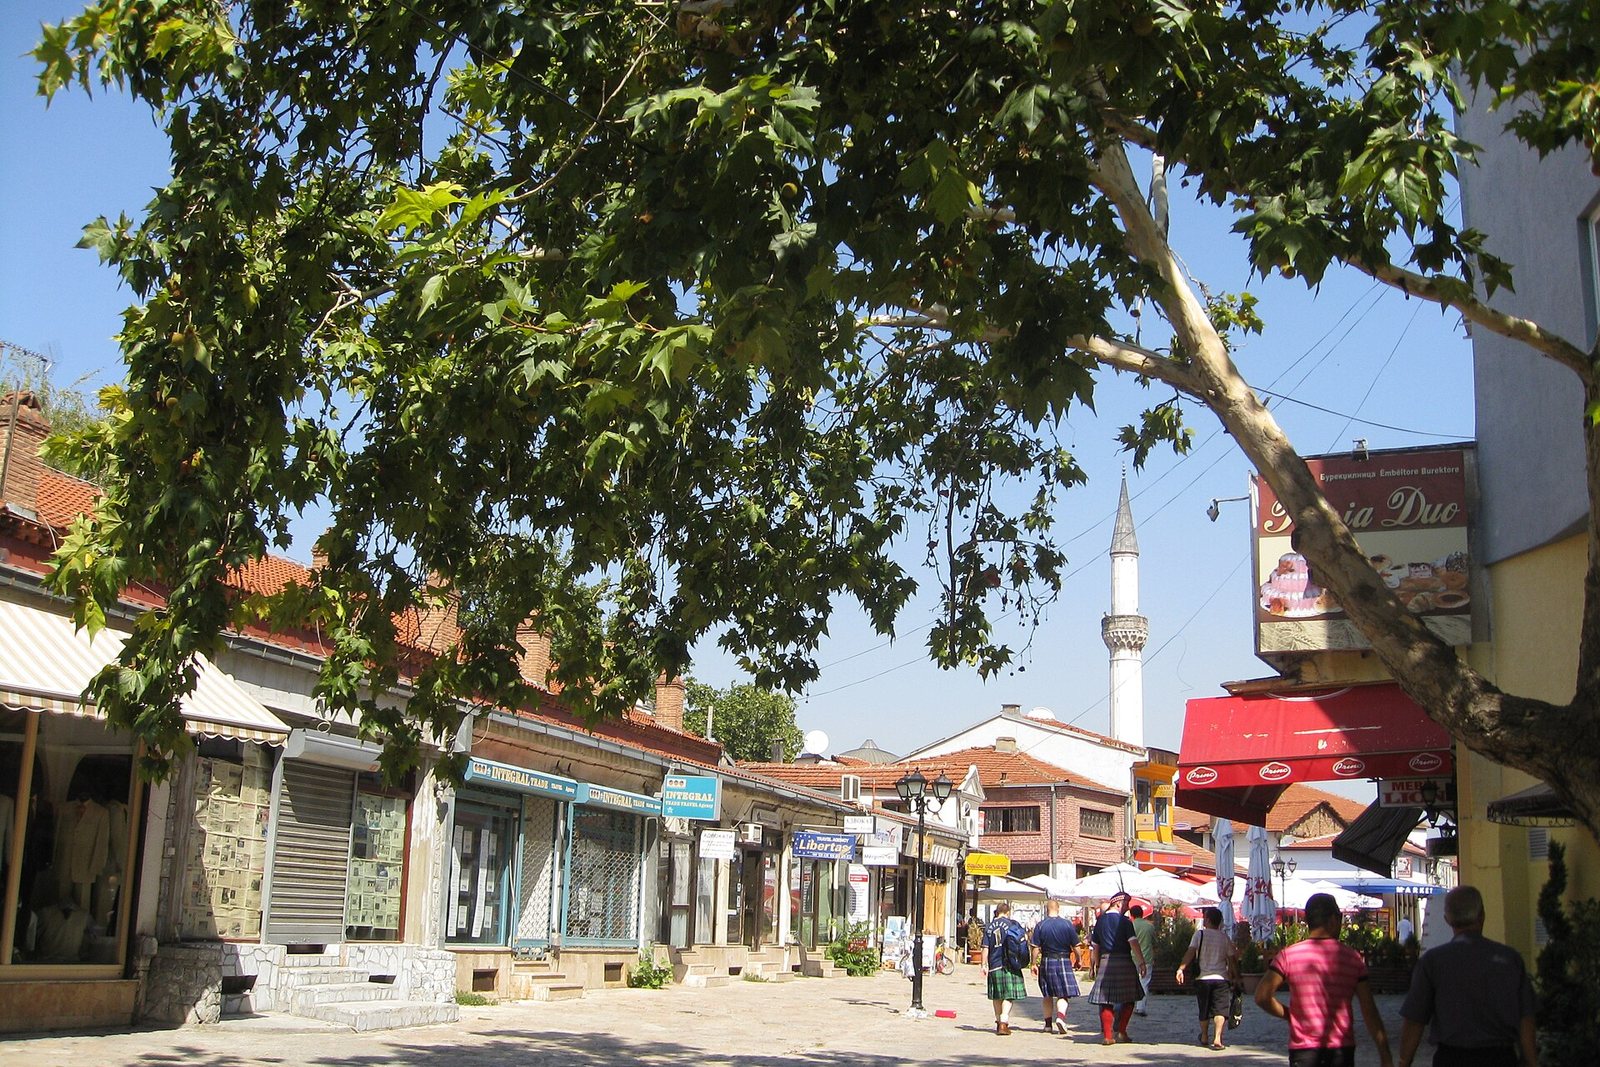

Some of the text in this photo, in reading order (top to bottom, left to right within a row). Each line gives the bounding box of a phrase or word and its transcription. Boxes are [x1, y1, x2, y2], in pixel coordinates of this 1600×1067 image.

[1381, 486, 1461, 527] Duo
[491, 766, 531, 787] INTEGRAL
[602, 791, 633, 808] INTEGRAL
[664, 790, 714, 802] INTEGRAL
[799, 839, 851, 853] Libertas
[1395, 886, 1434, 894] MARKET
